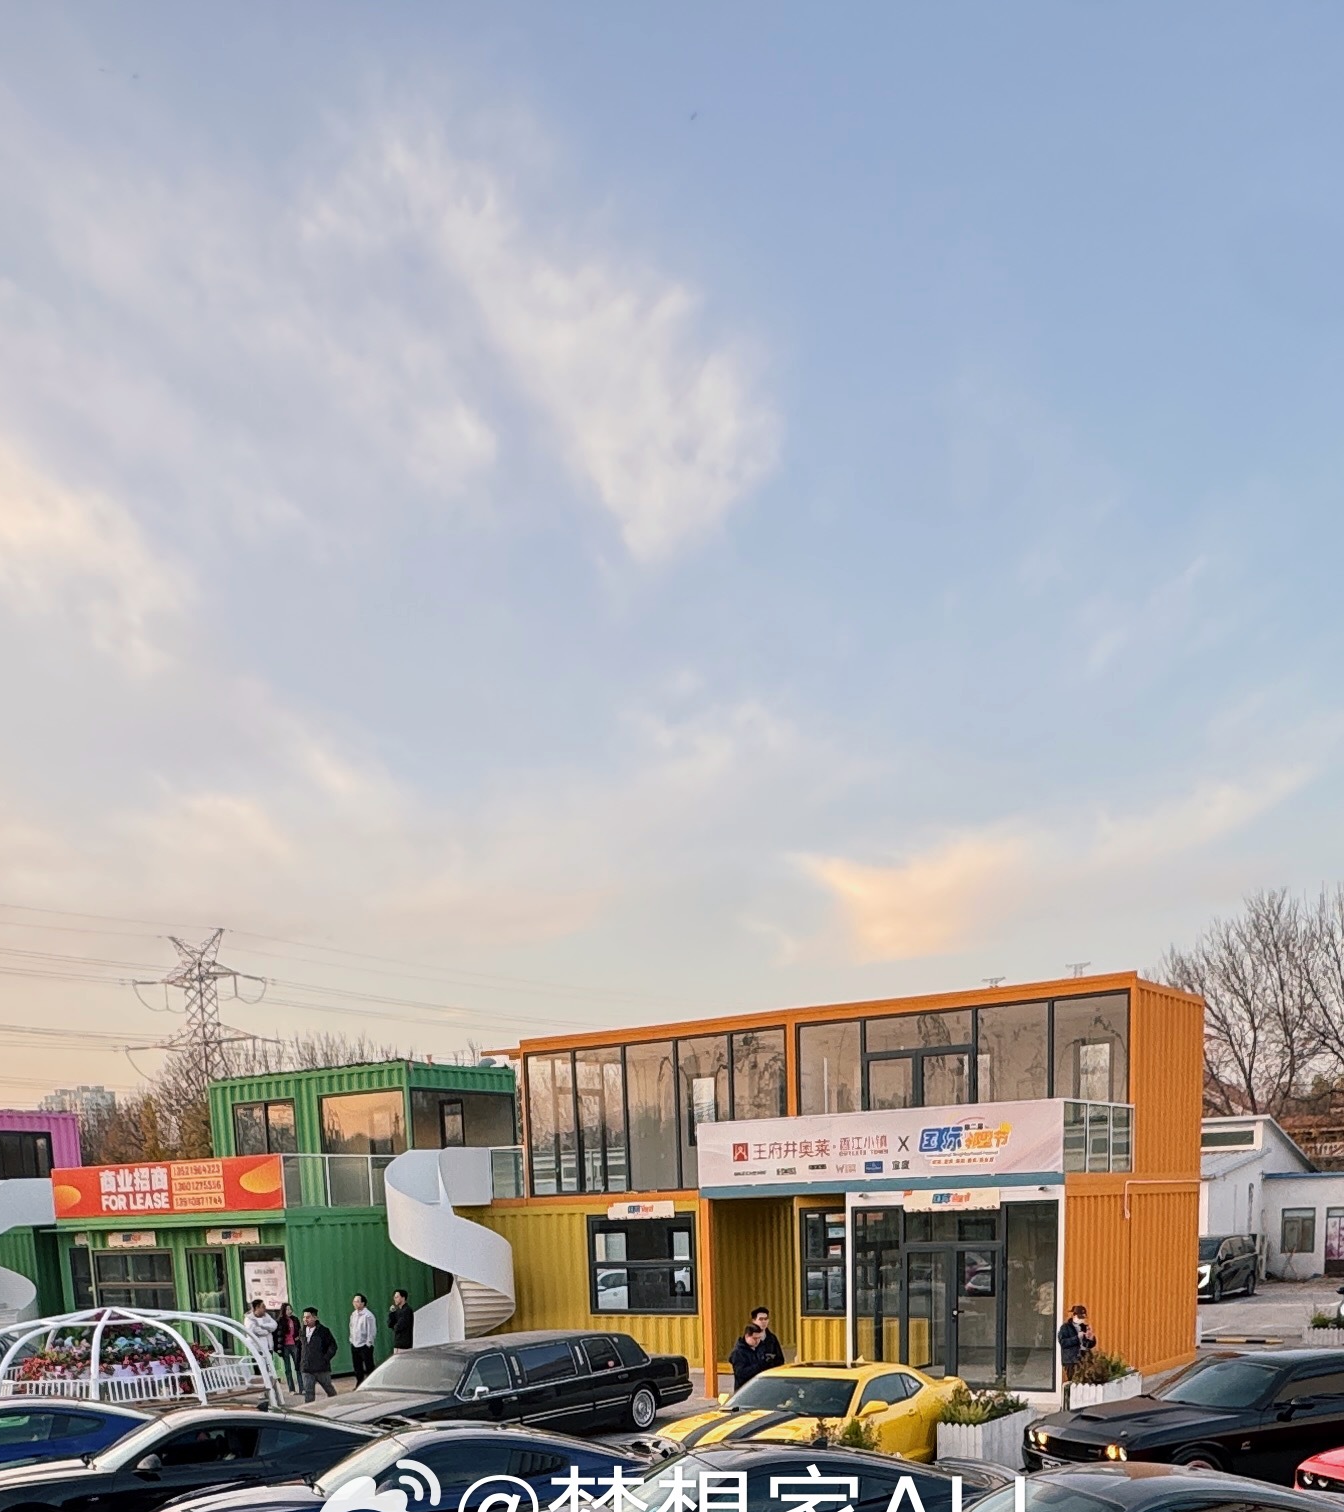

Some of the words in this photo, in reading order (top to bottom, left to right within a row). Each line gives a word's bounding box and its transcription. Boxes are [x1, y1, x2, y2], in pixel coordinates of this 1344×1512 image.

[99, 1166, 169, 1193] 商业招商
[102, 1194, 127, 1211] FOR
[129, 1192, 170, 1210] LEASE
